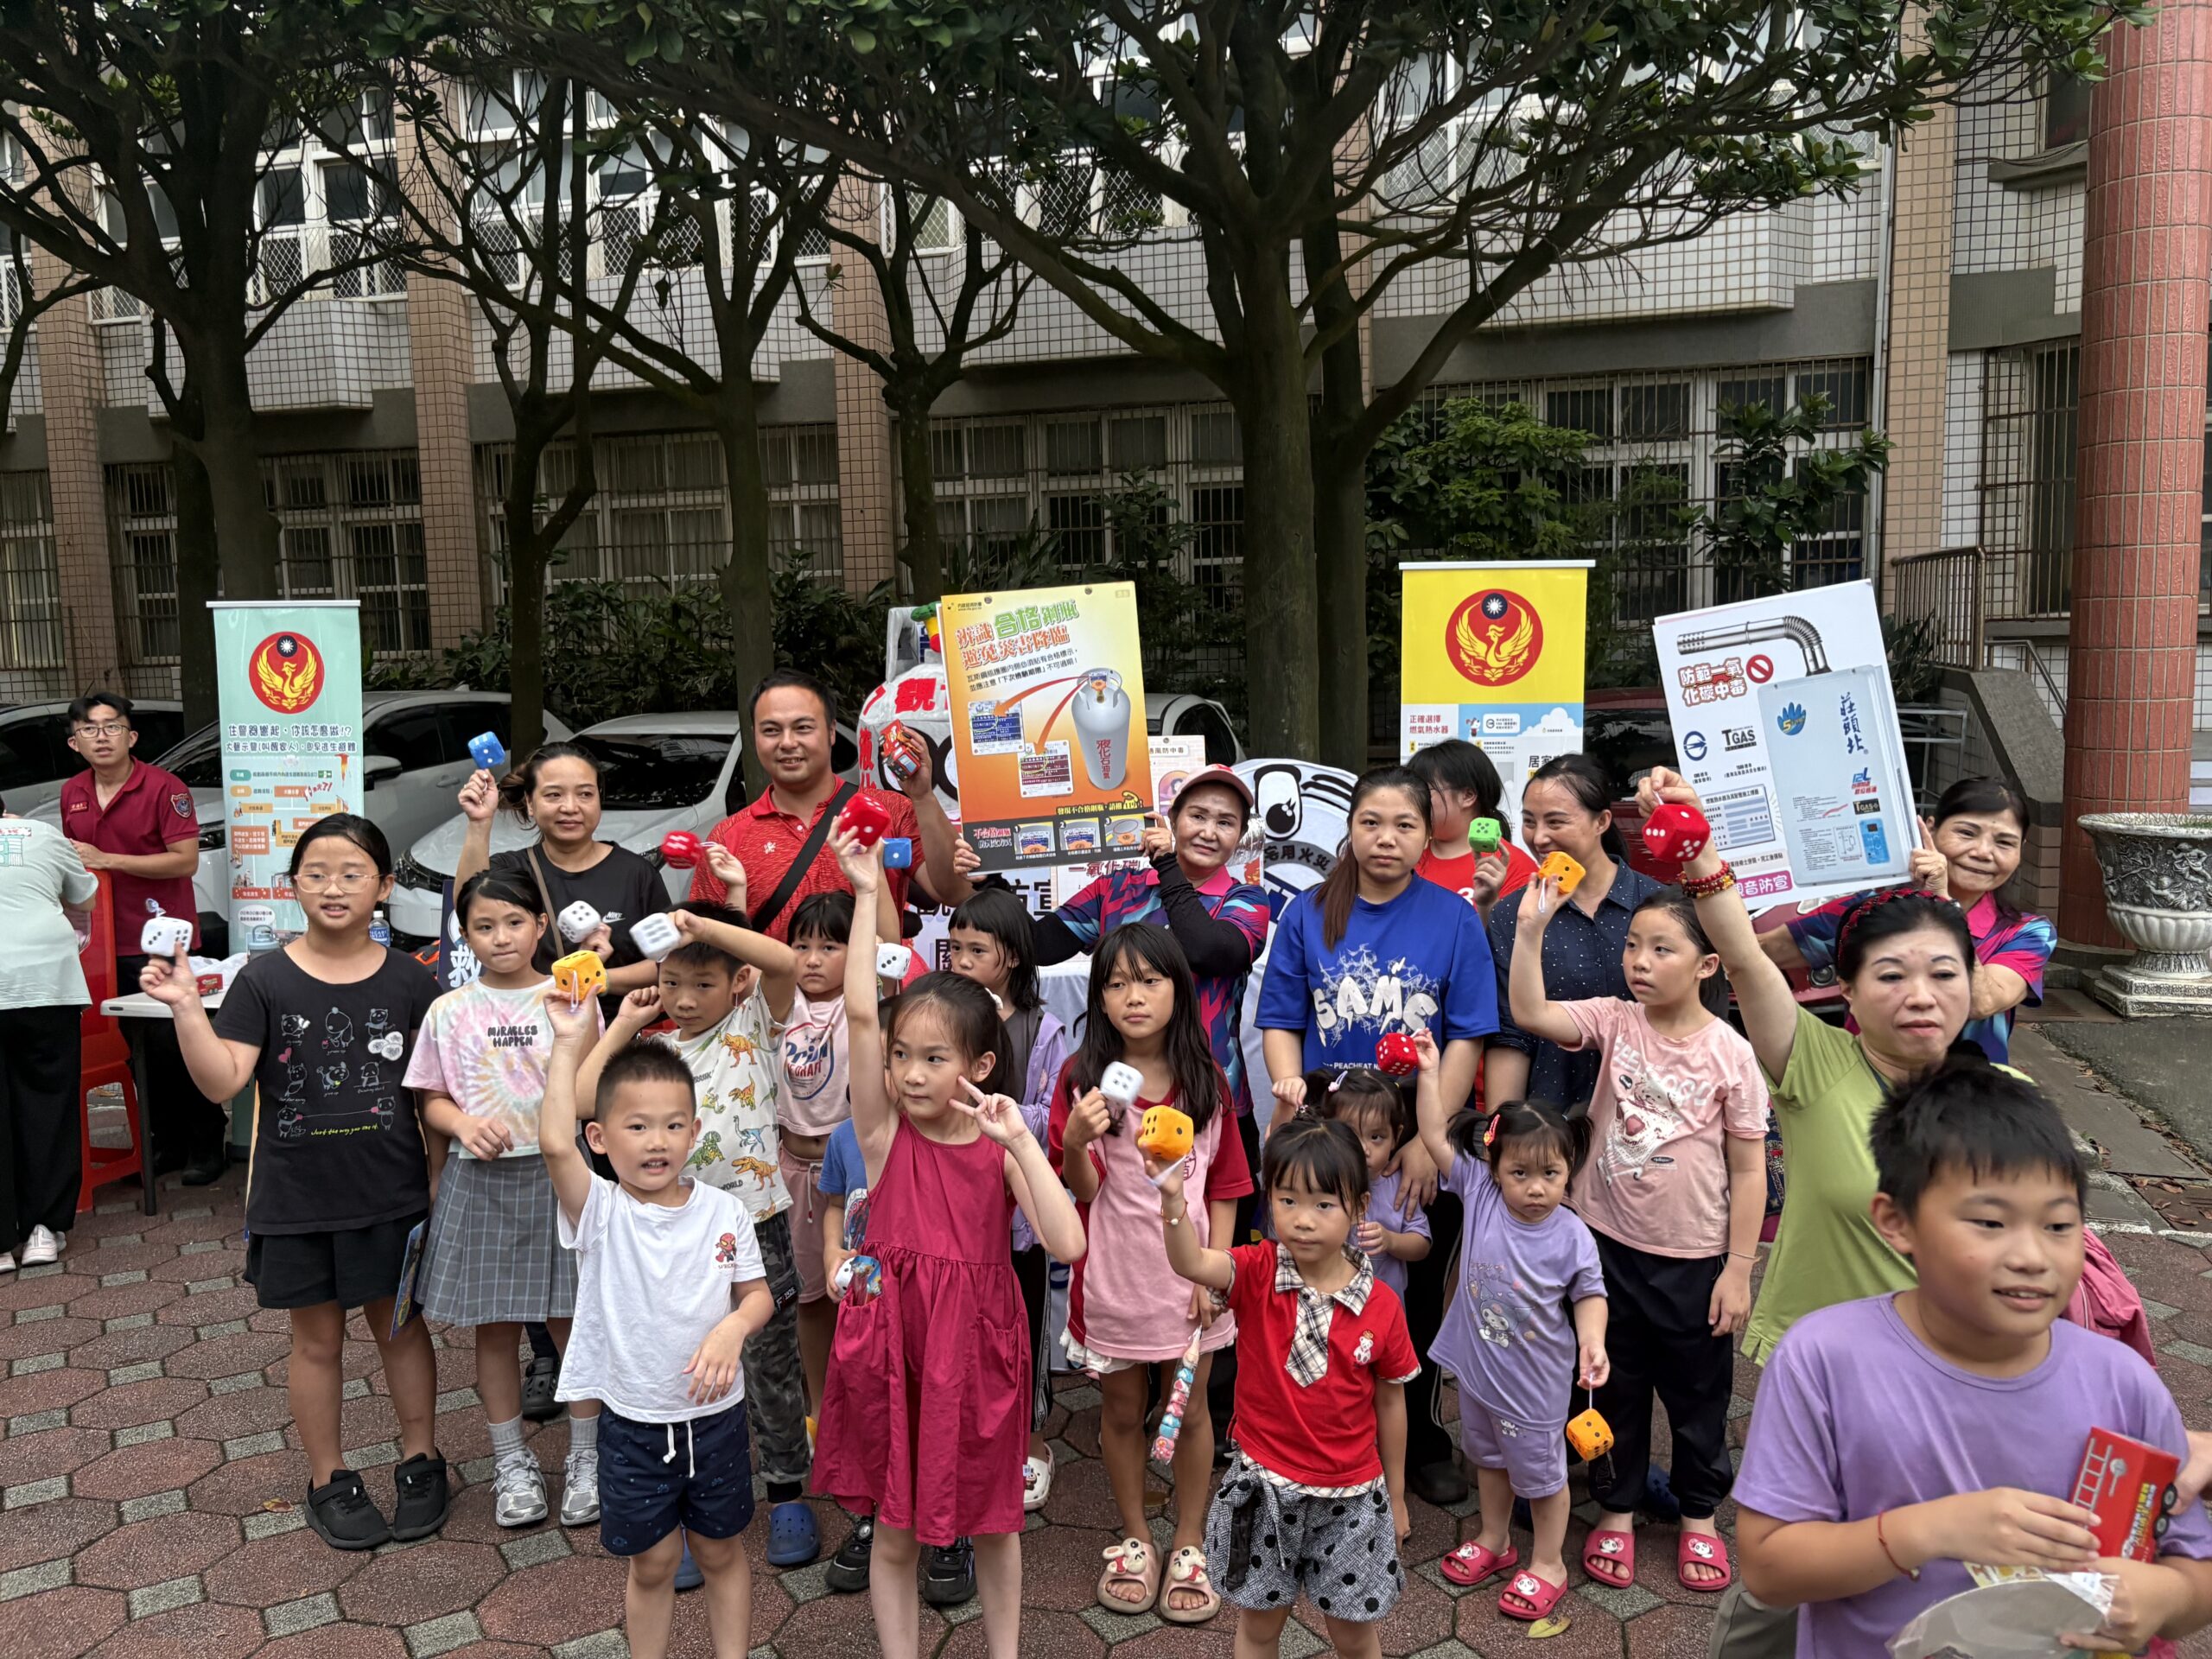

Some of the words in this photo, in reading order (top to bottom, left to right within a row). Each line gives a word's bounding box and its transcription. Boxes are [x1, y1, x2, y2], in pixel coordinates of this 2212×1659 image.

[962, 626, 1070, 670] 避免災害降臨
[1679, 658, 1744, 688] 防範一氧
[1682, 677, 1747, 707] 化碳中毒
[1409, 715, 1441, 723] 正確選擇
[1840, 692, 1865, 753] 莊頭北
[1721, 729, 1756, 747] TGAS
[1096, 739, 1111, 779] 液化石油氣
[1529, 755, 1559, 768] 居家
[1313, 975, 1439, 1039] SAME
[493, 1036, 532, 1047] HAPPEN
